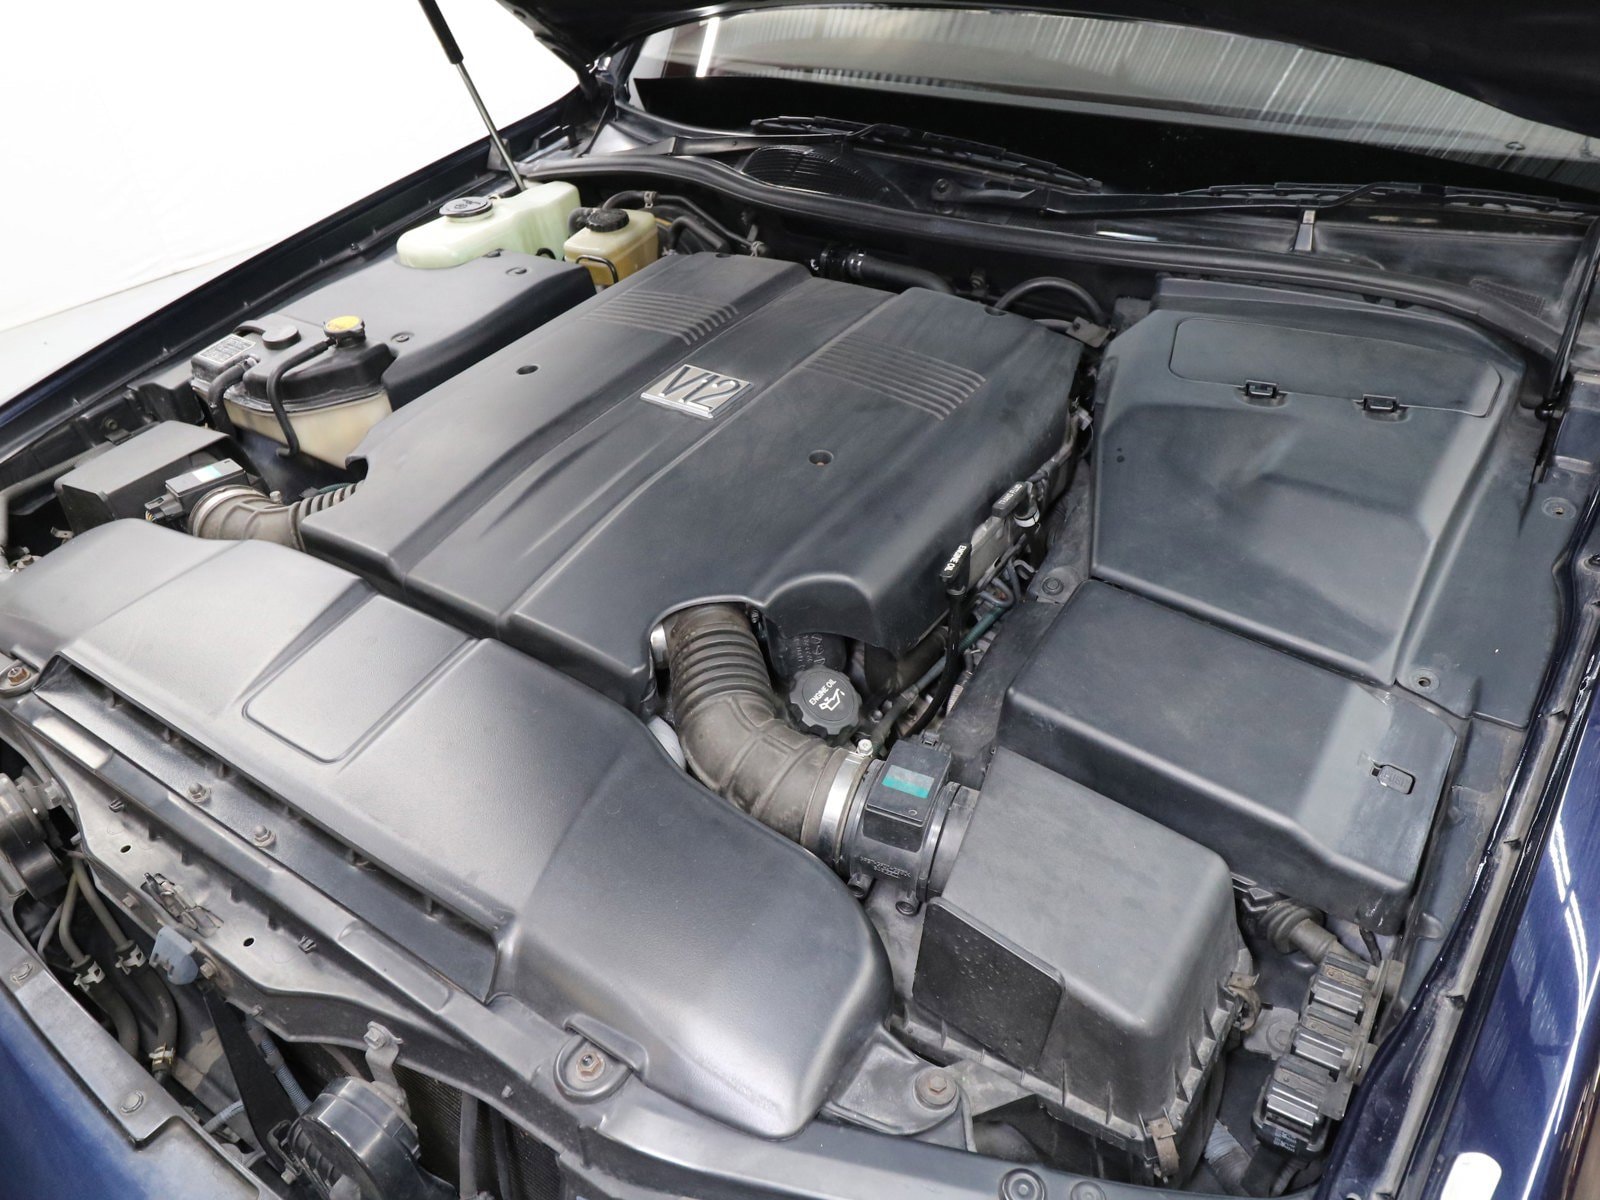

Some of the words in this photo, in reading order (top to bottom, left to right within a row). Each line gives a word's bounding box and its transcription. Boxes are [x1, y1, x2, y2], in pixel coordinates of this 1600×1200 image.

[659, 366, 742, 412] V12
[944, 562, 956, 572] OIL
[949, 545, 967, 565] ENGINE
[808, 685, 829, 706] ENGINE
[825, 678, 837, 690] OIL
